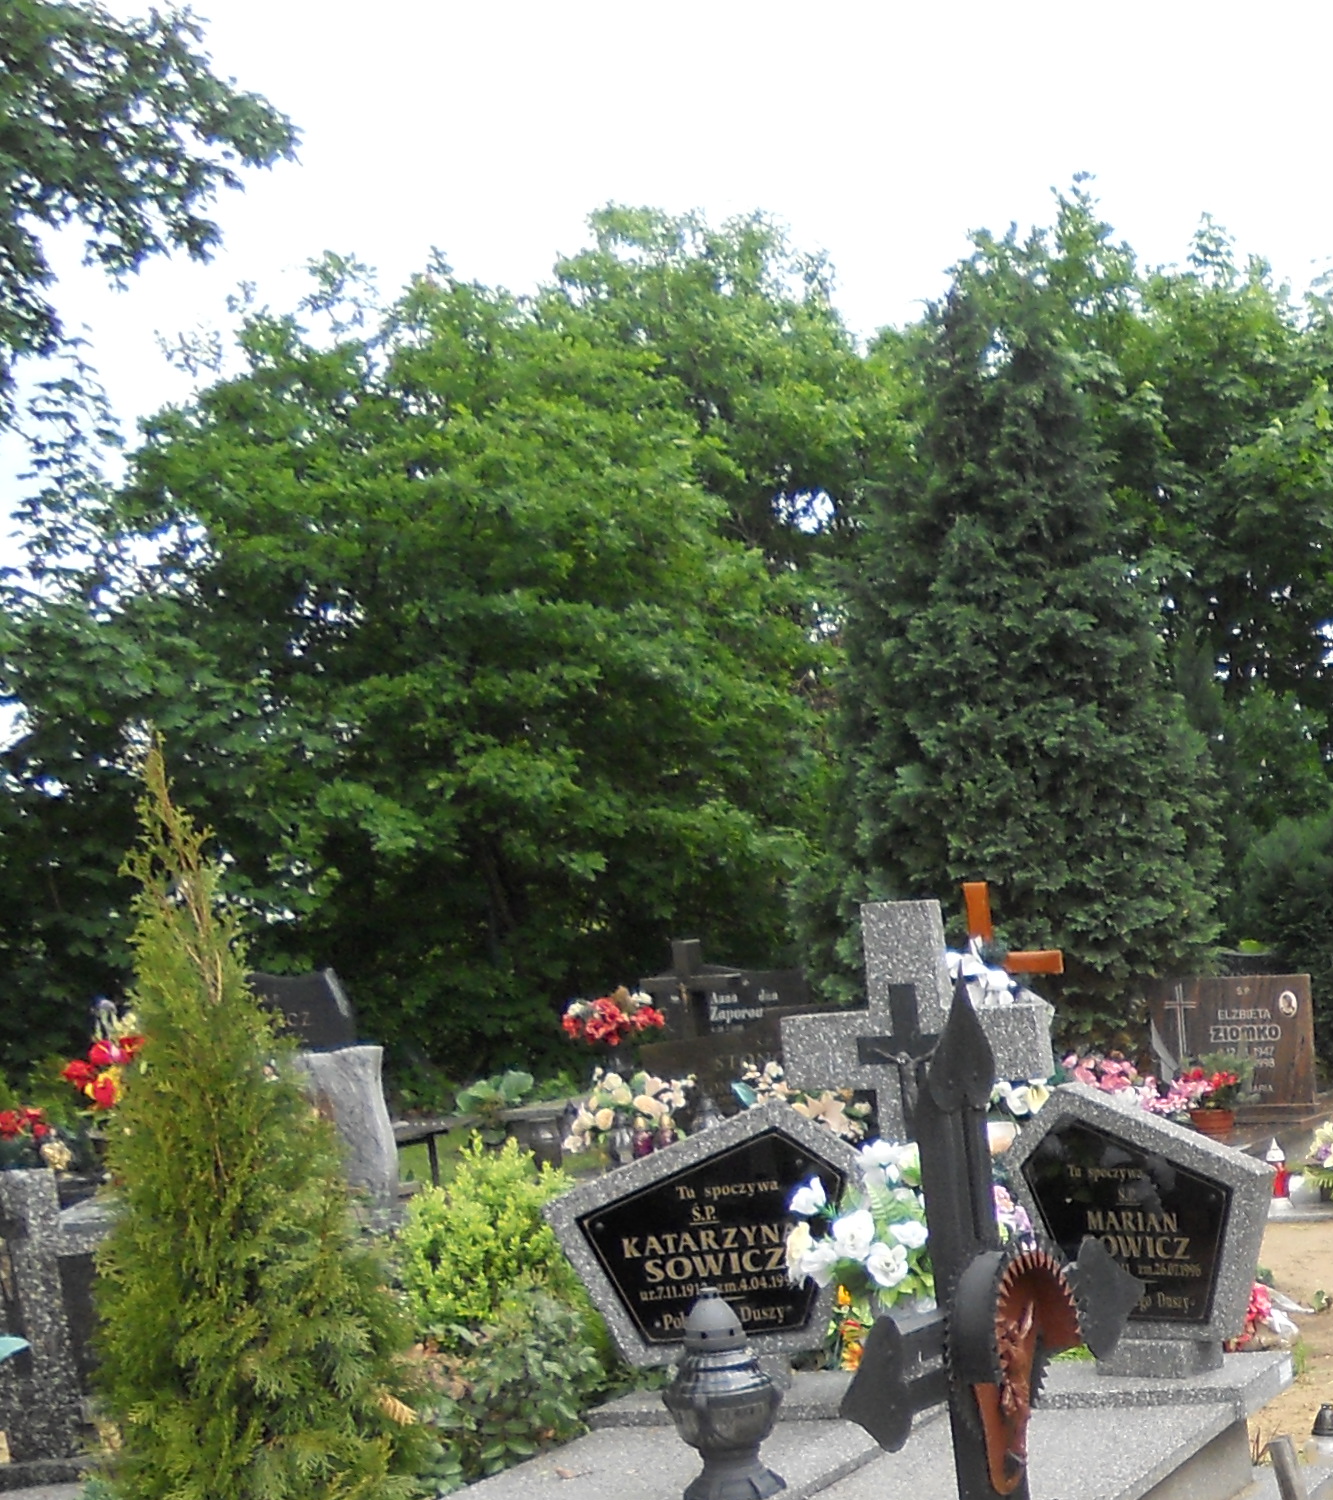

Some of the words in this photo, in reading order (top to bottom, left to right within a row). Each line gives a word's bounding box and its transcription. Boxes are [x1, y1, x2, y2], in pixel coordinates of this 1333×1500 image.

[676, 1184, 696, 1200] Tu
[705, 1178, 779, 1197] spoczywa
[1087, 1210, 1178, 1233] MARIAN
[645, 1246, 787, 1283] SOWICZ
[740, 1304, 785, 1324] Duszy
